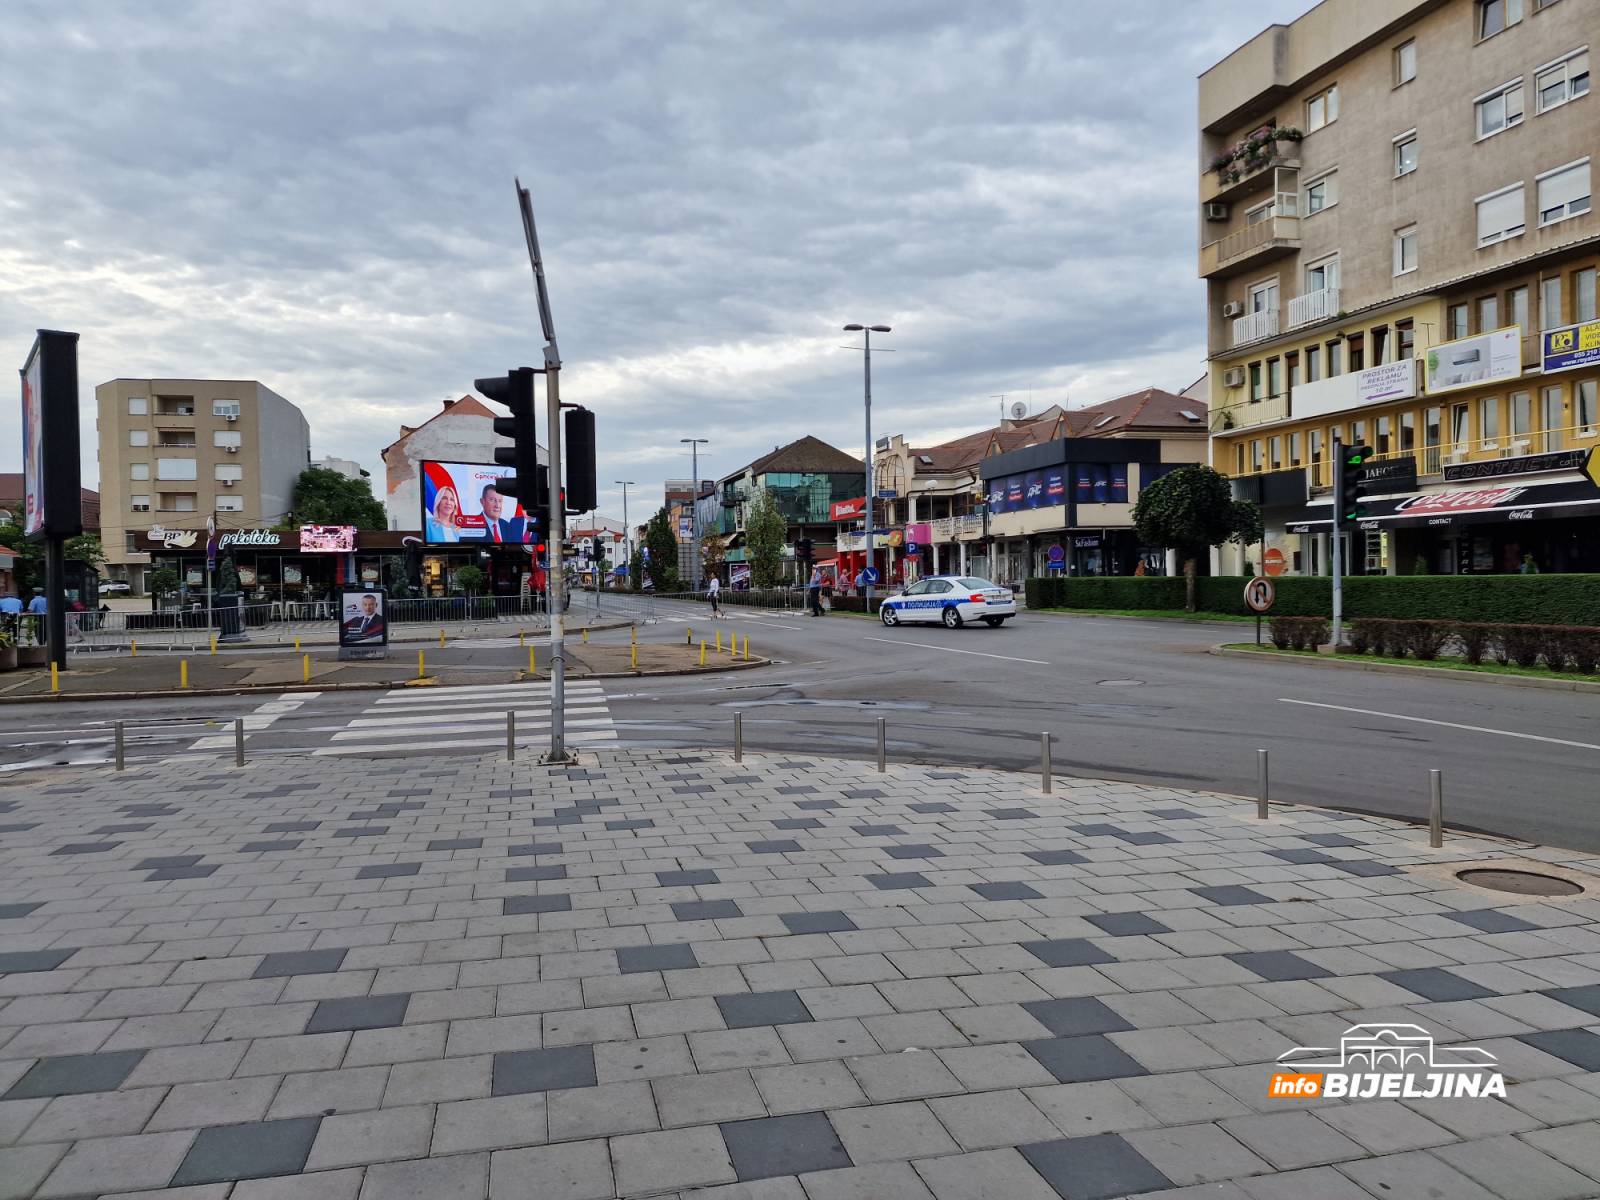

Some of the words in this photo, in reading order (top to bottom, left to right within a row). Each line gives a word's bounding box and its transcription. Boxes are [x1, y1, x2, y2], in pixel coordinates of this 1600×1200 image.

[1362, 366, 1395, 378] PROSTOR
[1366, 372, 1402, 384] REKLAMU
[1446, 456, 1558, 479] CONTACT
[219, 529, 281, 550] pekoteka
[908, 544, 915, 552] P
